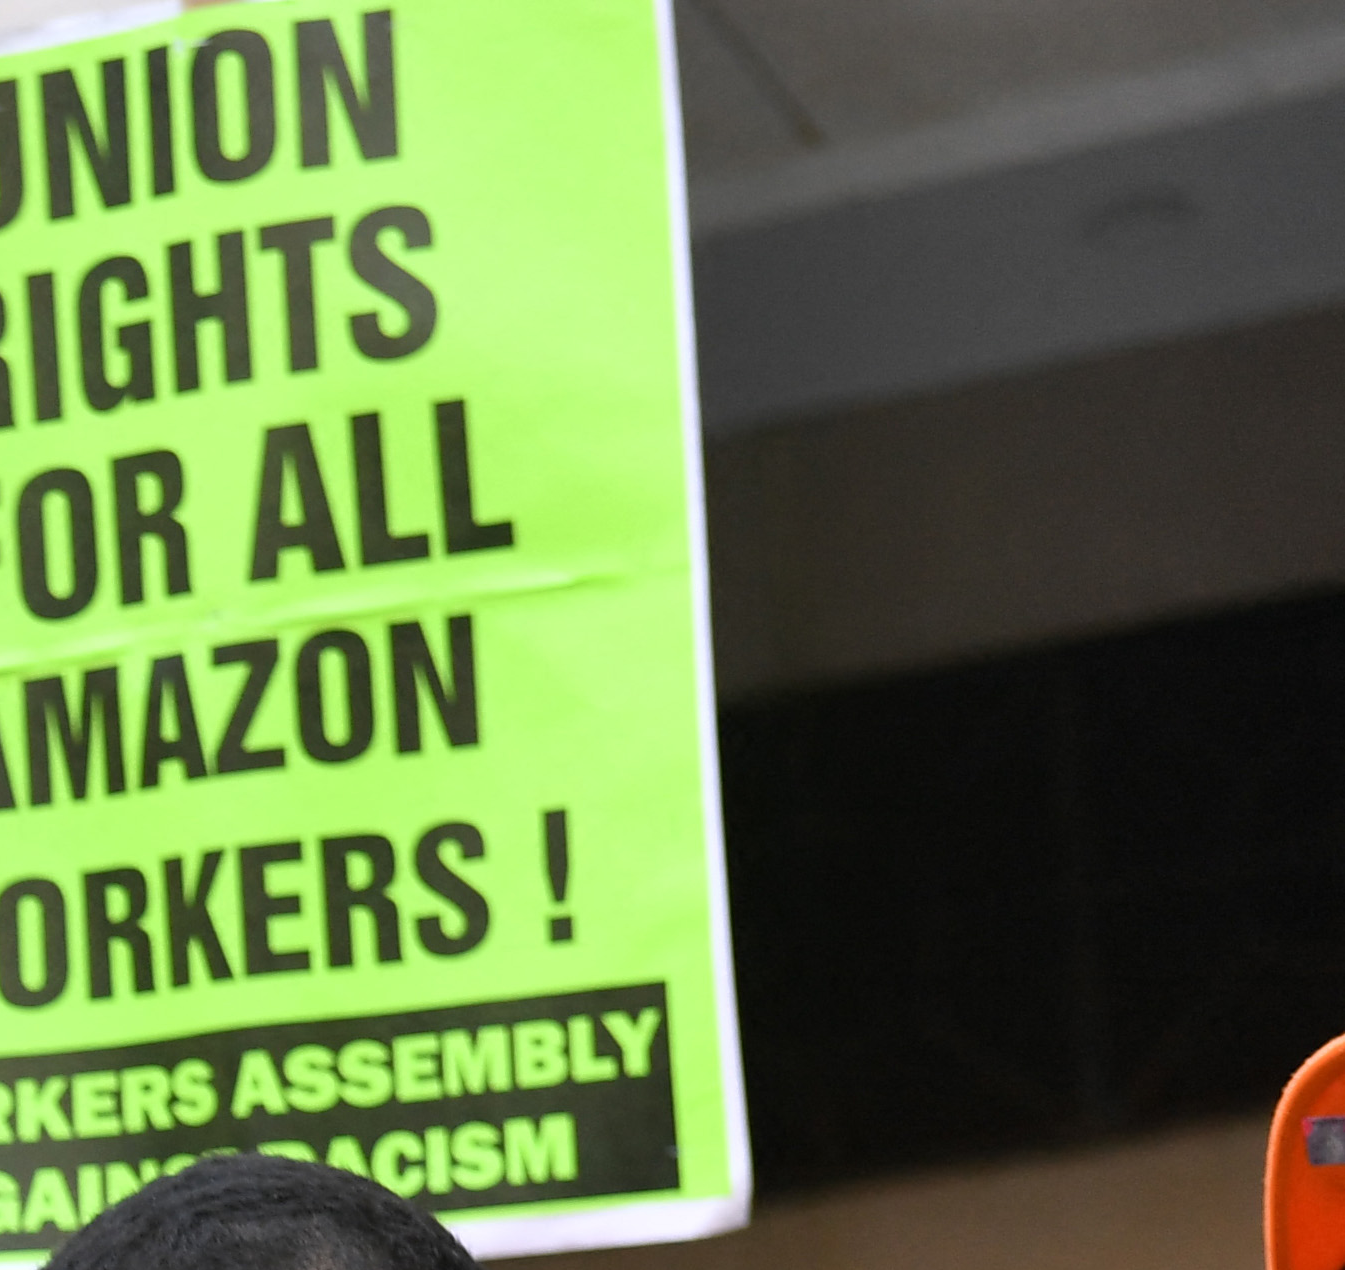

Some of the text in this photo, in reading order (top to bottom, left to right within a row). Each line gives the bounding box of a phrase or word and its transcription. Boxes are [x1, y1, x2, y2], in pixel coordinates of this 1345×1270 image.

[248, 398, 517, 583] ALL
[232, 1006, 663, 1120] ASSEMBLY
[257, 1111, 578, 1200] CISM
